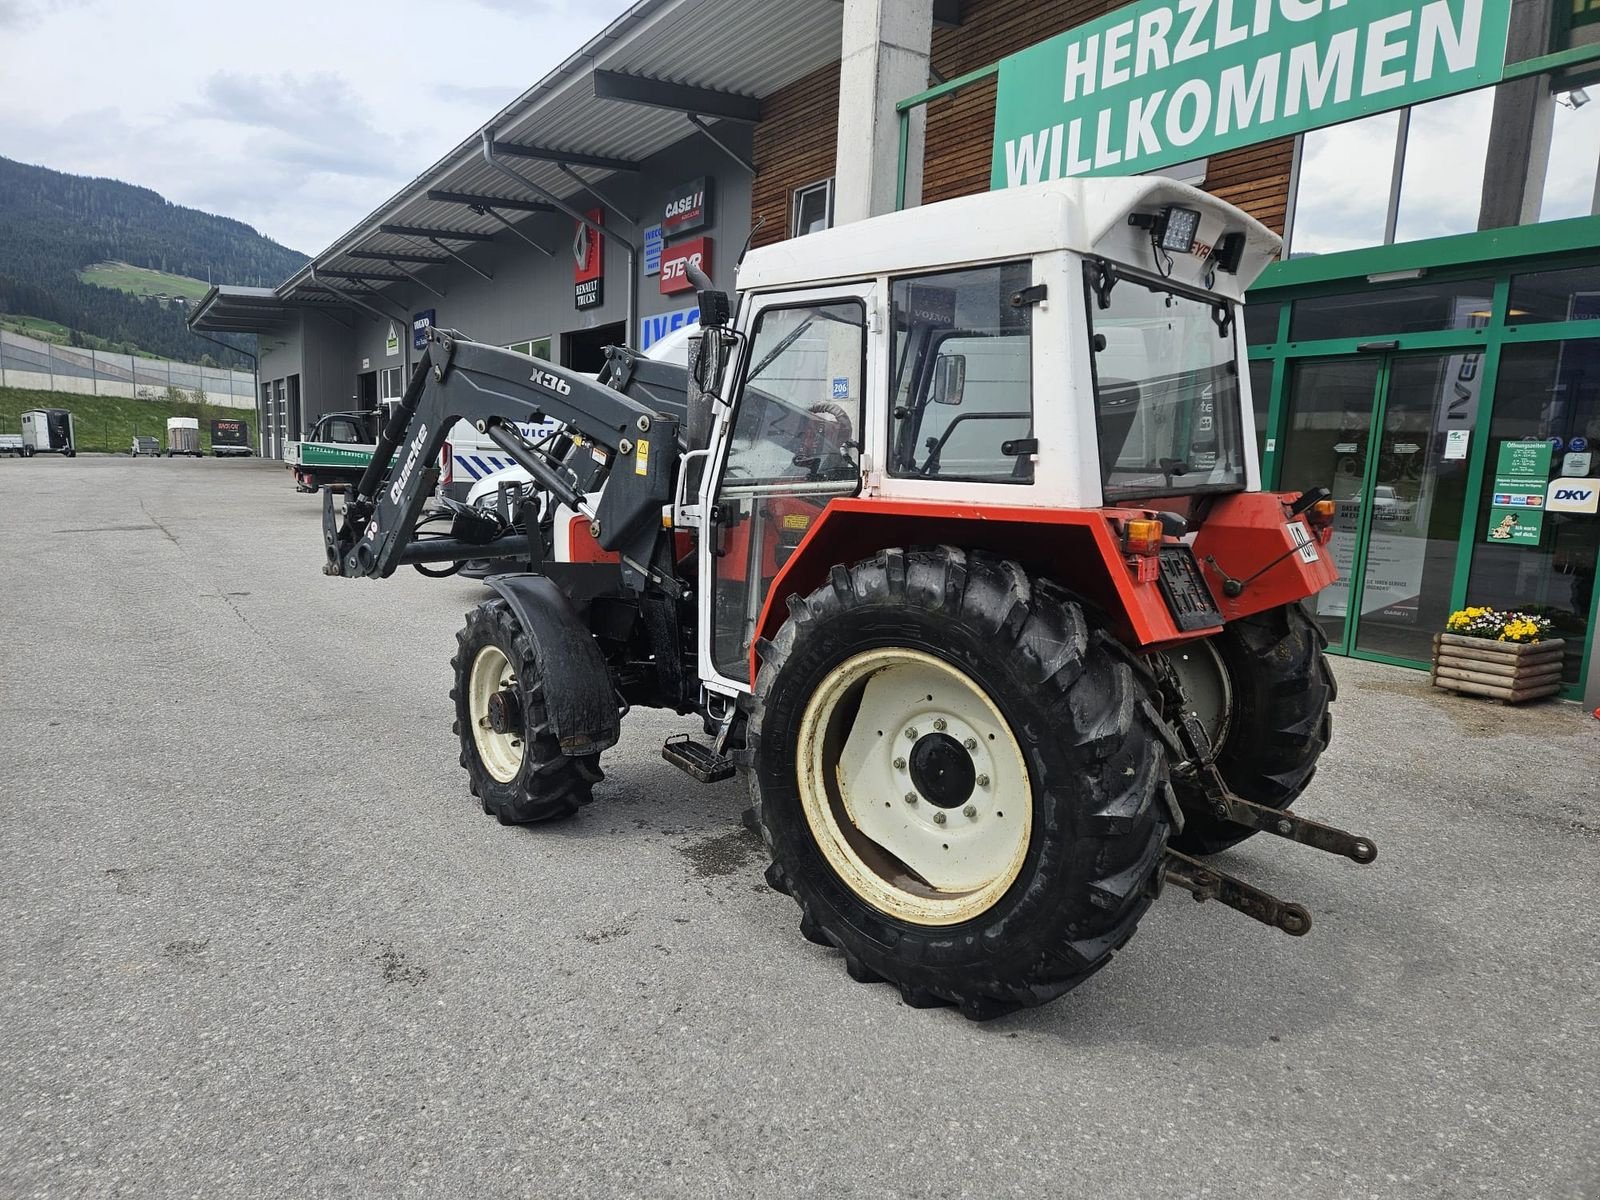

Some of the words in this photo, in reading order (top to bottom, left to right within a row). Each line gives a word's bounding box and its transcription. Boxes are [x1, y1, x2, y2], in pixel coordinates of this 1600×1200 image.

[1063, 0, 1348, 103] HERZLI
[1005, 0, 1483, 188] WILLKOMMEN
[665, 196, 693, 218] CASE
[1191, 240, 1211, 259] EYR
[575, 280, 598, 296] RENAULT
[577, 292, 596, 306] TRUCKS
[834, 383, 847, 393] 206
[520, 428, 554, 438] VICE
[340, 451, 364, 459] SERVICE
[1554, 489, 1592, 501] DKV
